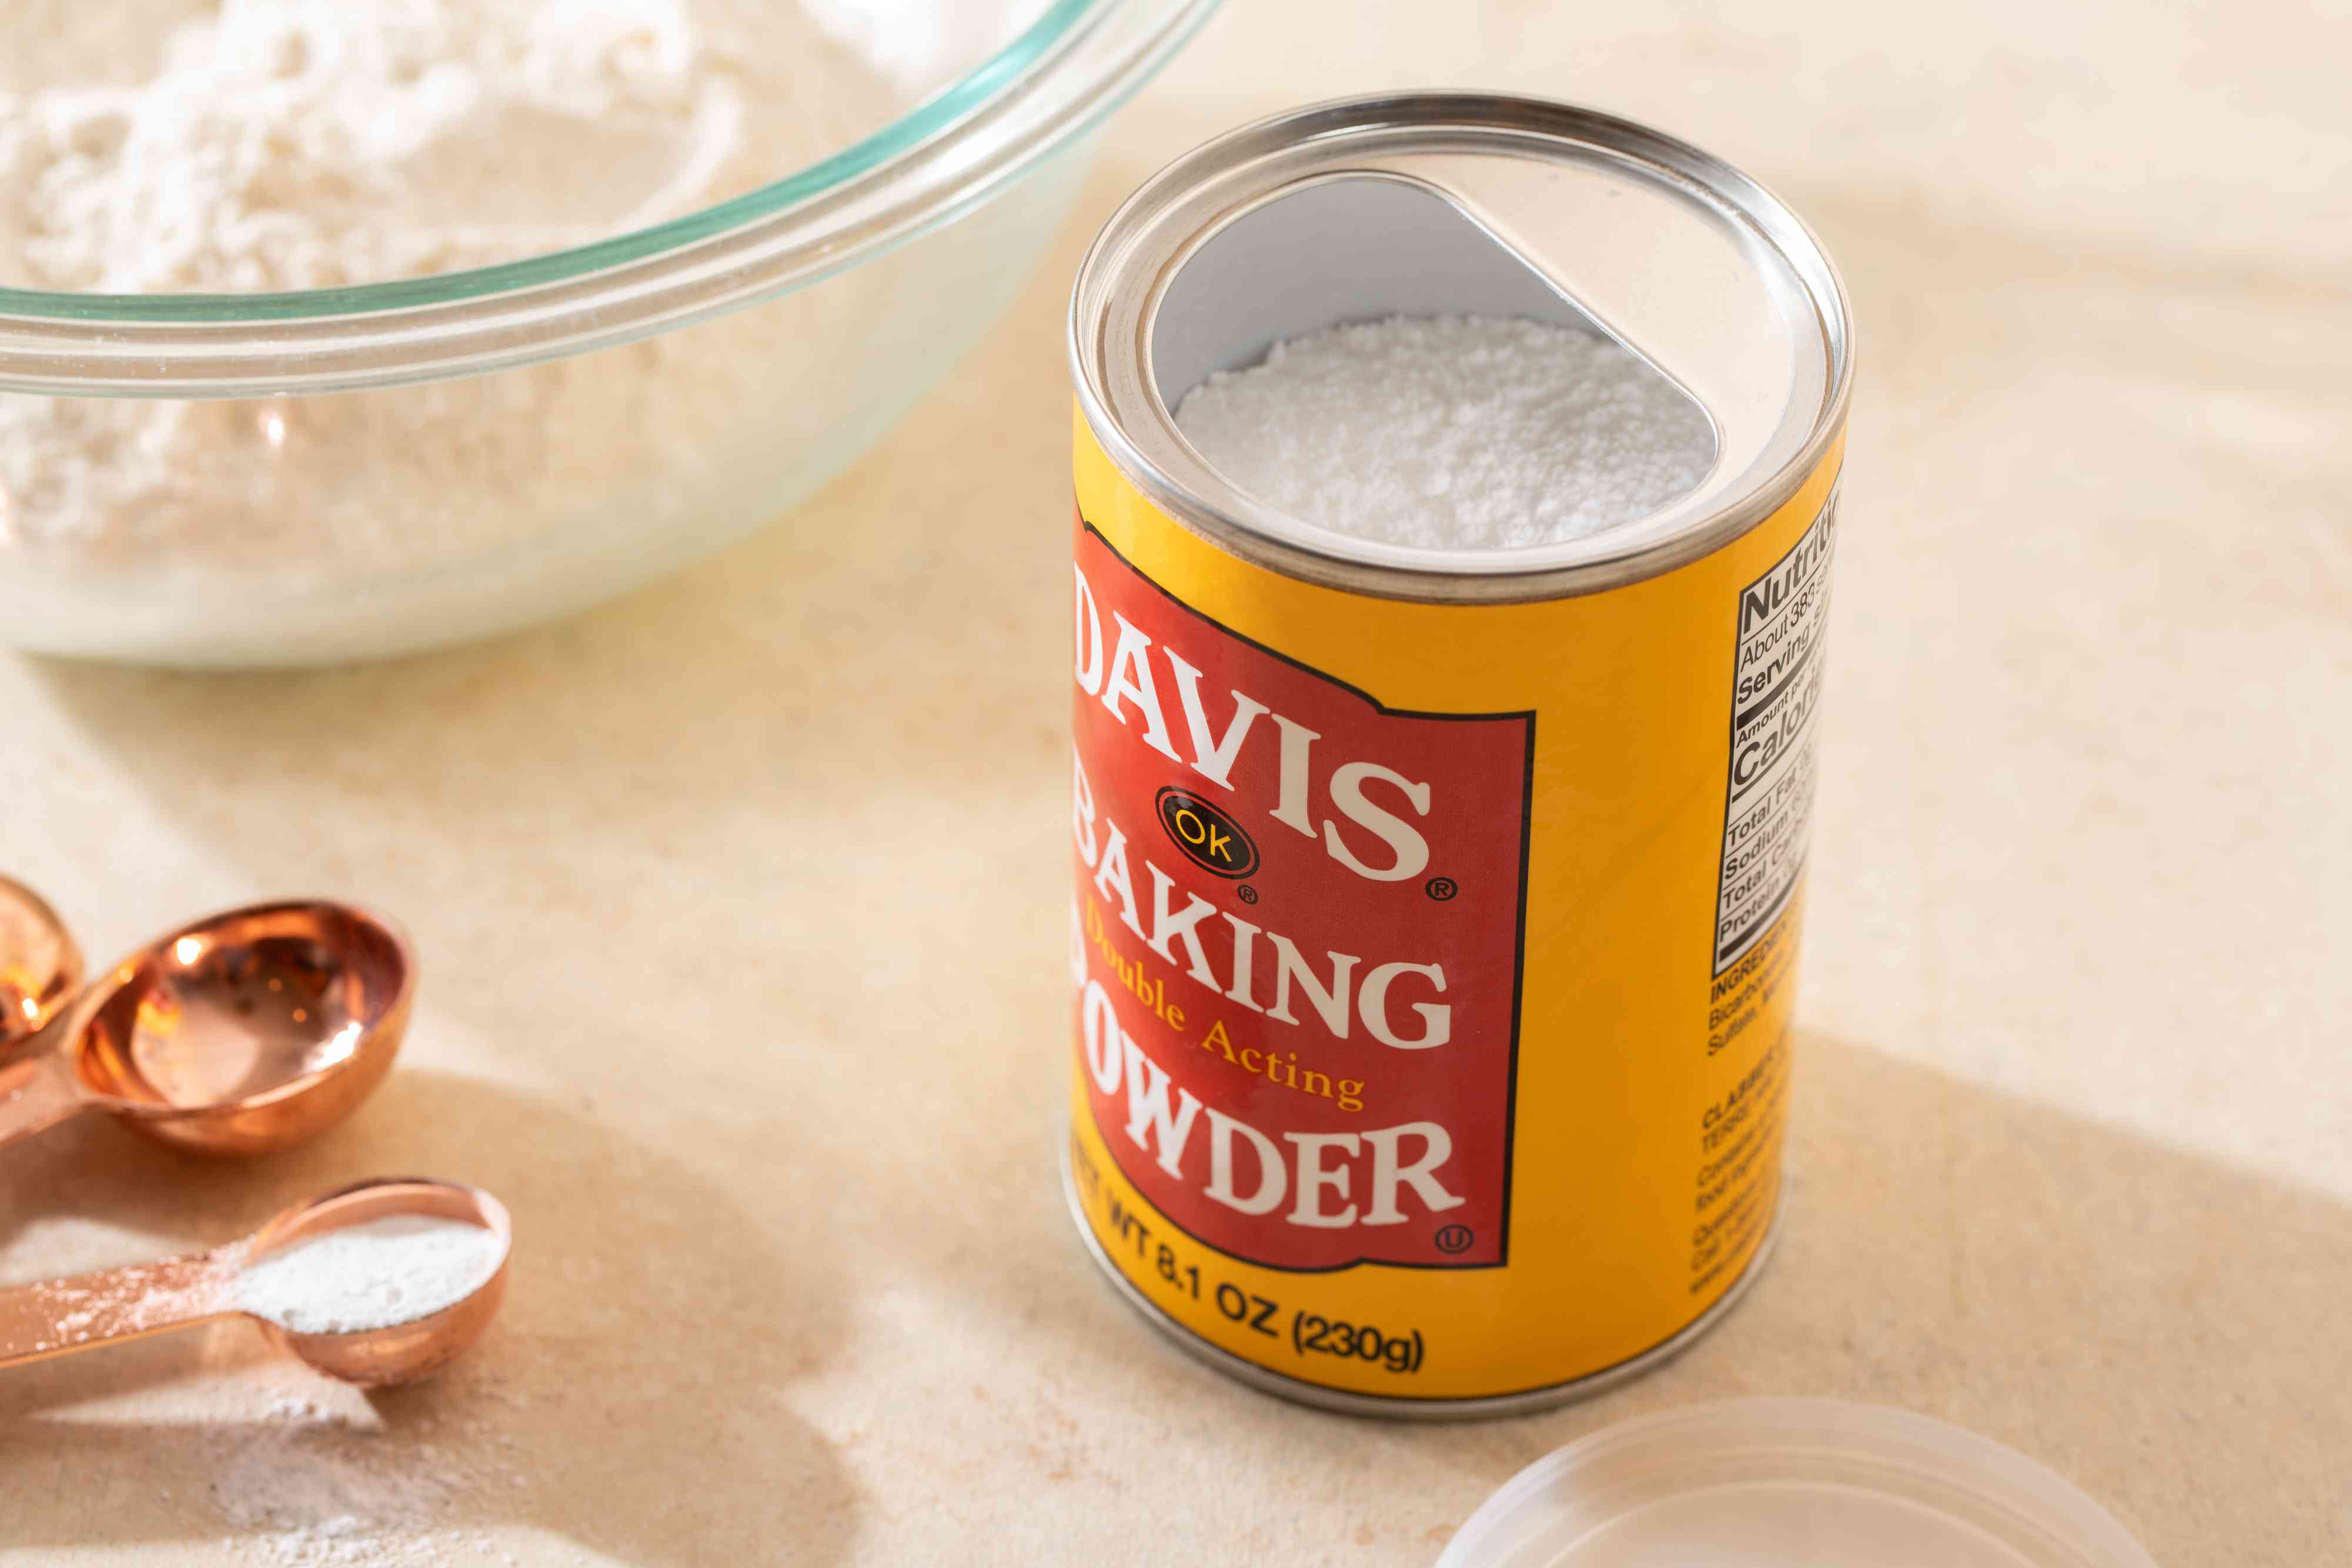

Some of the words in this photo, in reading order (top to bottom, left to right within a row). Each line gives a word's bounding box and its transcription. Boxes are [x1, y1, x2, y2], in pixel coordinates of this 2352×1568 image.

[1738, 621, 1810, 705] Serving
[1740, 614, 1788, 673] About
[1790, 581, 1815, 628] 383
[1073, 560, 1431, 882] DAVIS
[1736, 691, 1789, 749] Amount
[1177, 810, 1231, 862] OK
[1724, 809, 1788, 881] Sodium
[1728, 797, 1772, 847] Total
[1775, 767, 1797, 805] Fat
[1072, 741, 1451, 1050] BAKING
[1719, 876, 1780, 943] Protein
[1723, 860, 1767, 910] Total
[1087, 892, 1186, 1032] Double
[1201, 1020, 1365, 1113] Acting
[1107, 1186, 1151, 1261] WT
[1156, 1242, 1200, 1299] 8.1
[1216, 1283, 1280, 1338] OZ
[1292, 1310, 1424, 1374] (230g)
